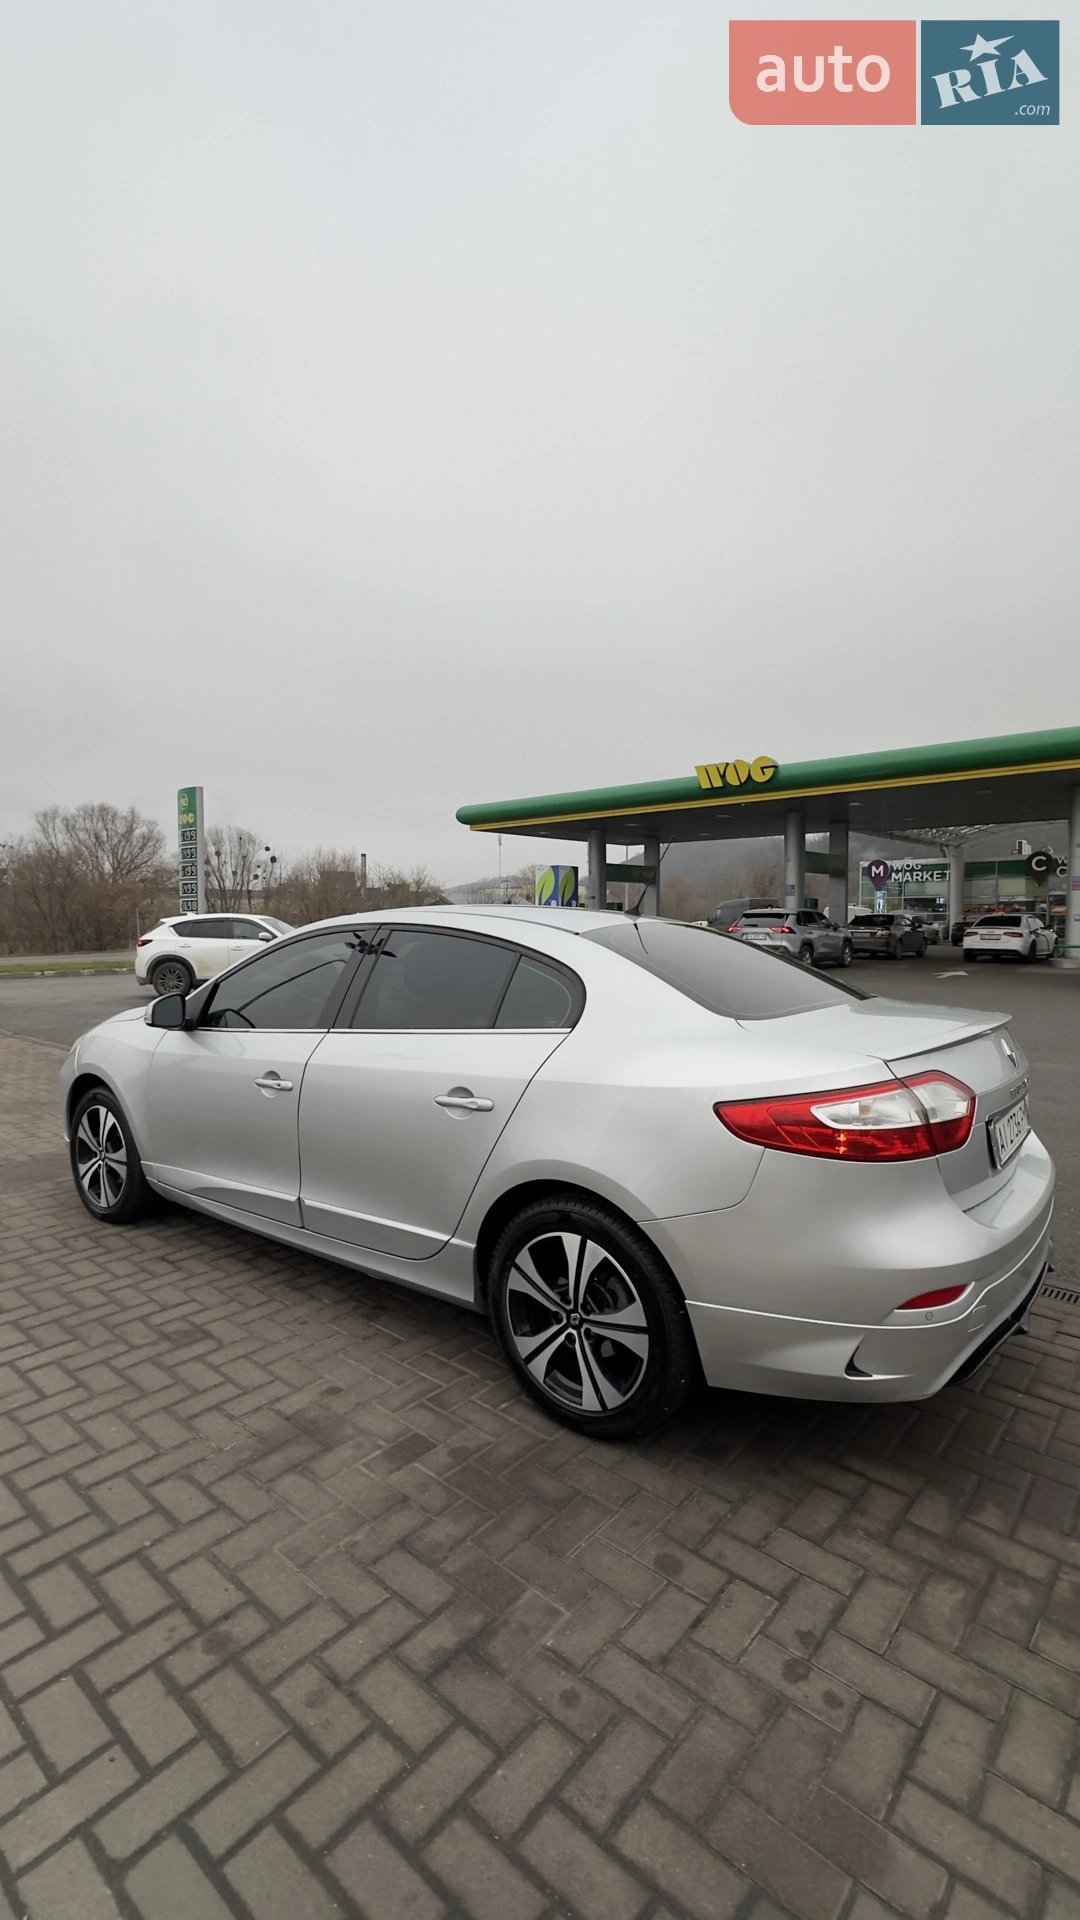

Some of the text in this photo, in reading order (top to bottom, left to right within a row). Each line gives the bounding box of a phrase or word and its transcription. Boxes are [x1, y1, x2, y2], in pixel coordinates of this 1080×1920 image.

[694, 755, 778, 790] WOG
[892, 862, 922, 871] WOG
[891, 870, 951, 883] MARKET
